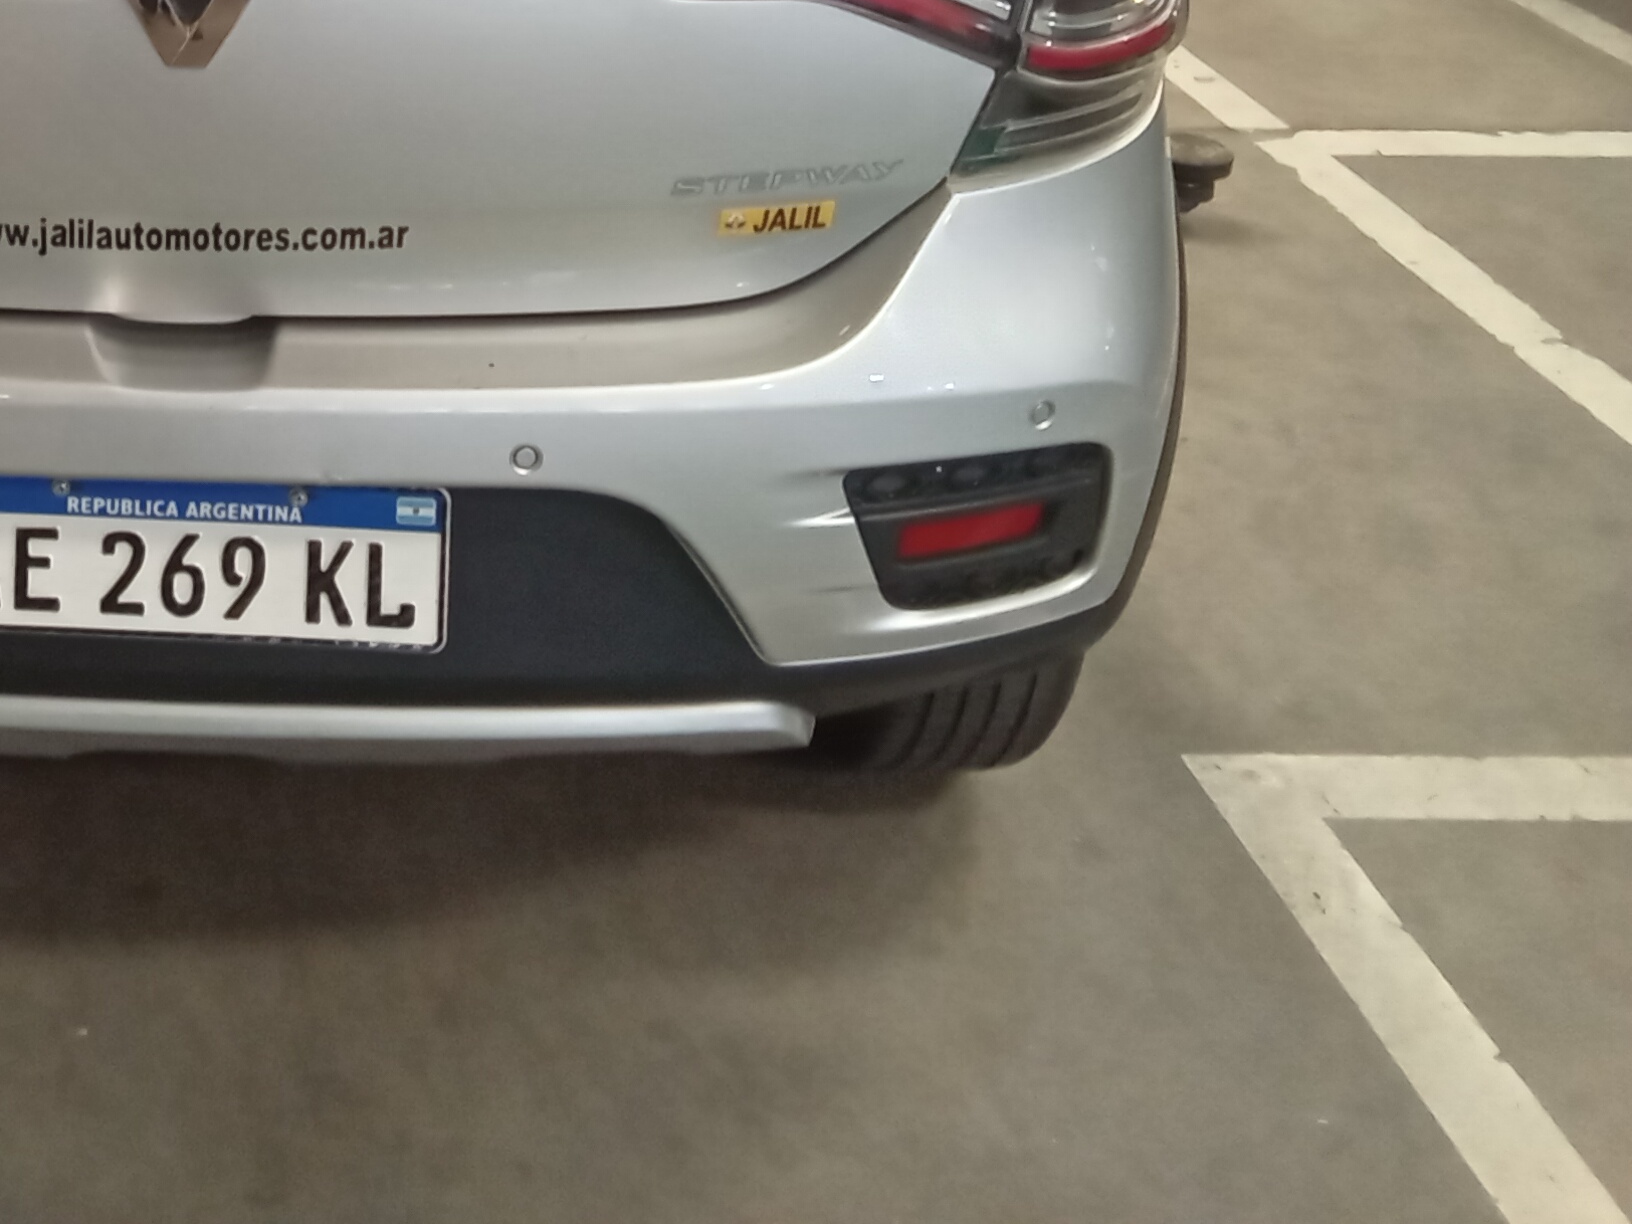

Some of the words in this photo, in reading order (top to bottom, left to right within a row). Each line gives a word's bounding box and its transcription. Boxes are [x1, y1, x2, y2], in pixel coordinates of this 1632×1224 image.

[670, 158, 904, 196] STEPWAY
[752, 205, 826, 233] JALIL
[67, 495, 179, 519] REPUBLICA
[185, 501, 303, 523] ARGENTINA
[99, 531, 266, 621] 269
[304, 538, 417, 630] KL
